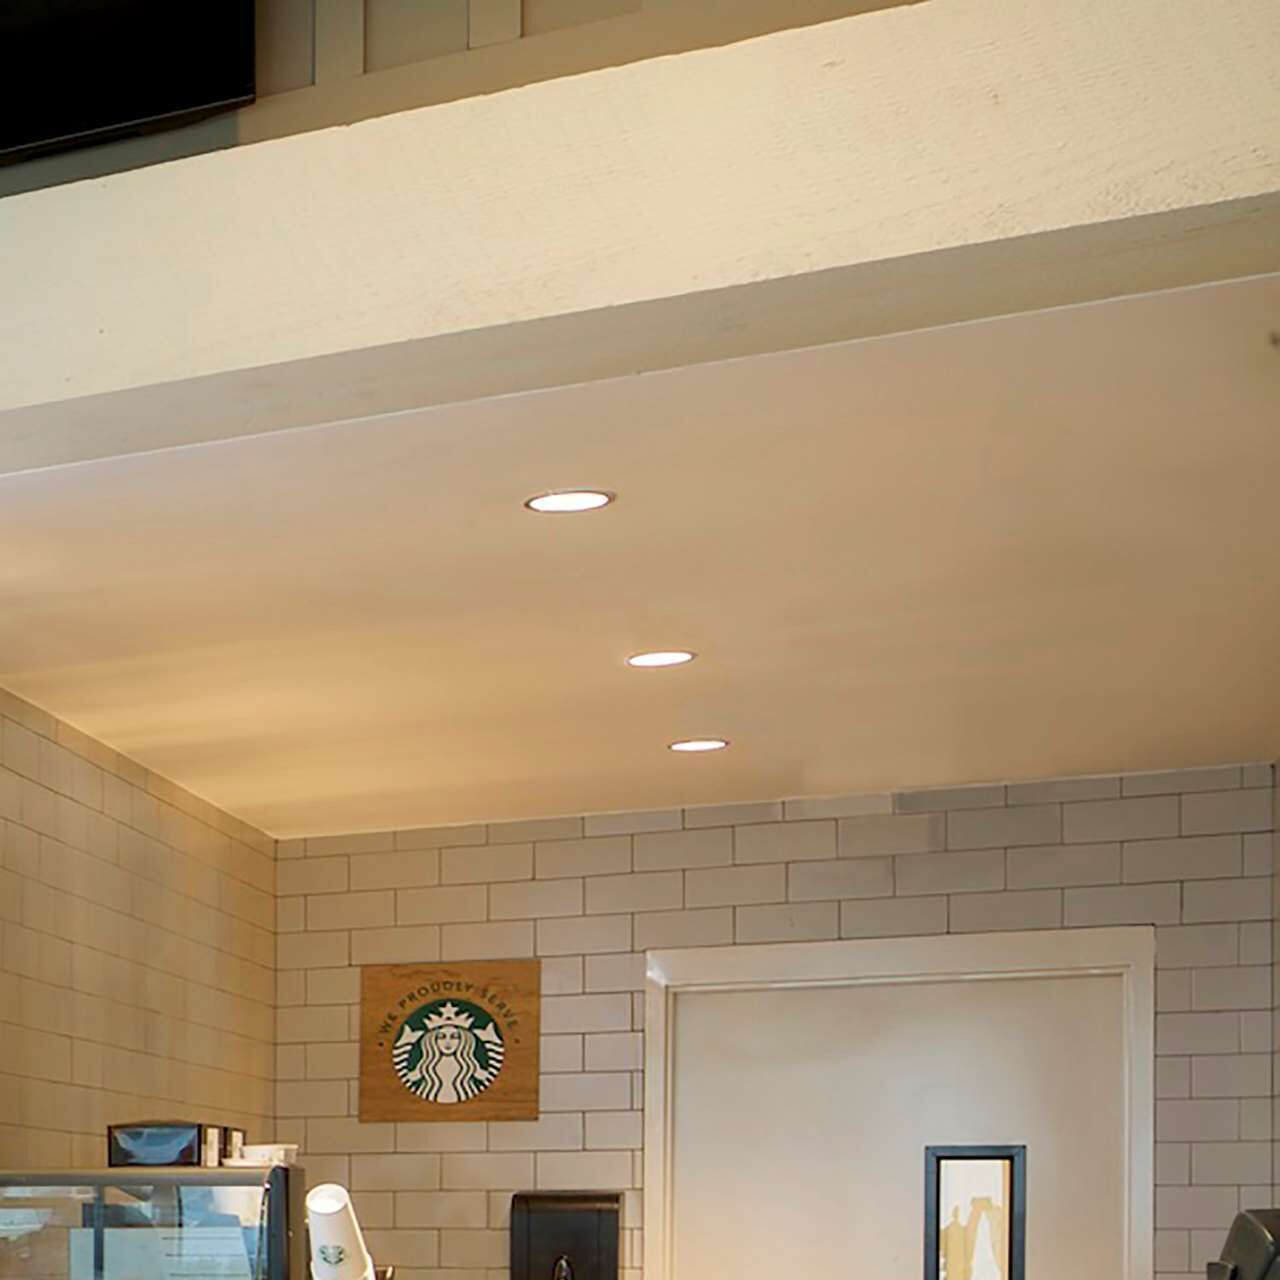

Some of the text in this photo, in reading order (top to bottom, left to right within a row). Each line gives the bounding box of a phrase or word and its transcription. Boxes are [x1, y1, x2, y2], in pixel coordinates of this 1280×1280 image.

[379, 980, 519, 1033] WE PROUDLY SERVE
